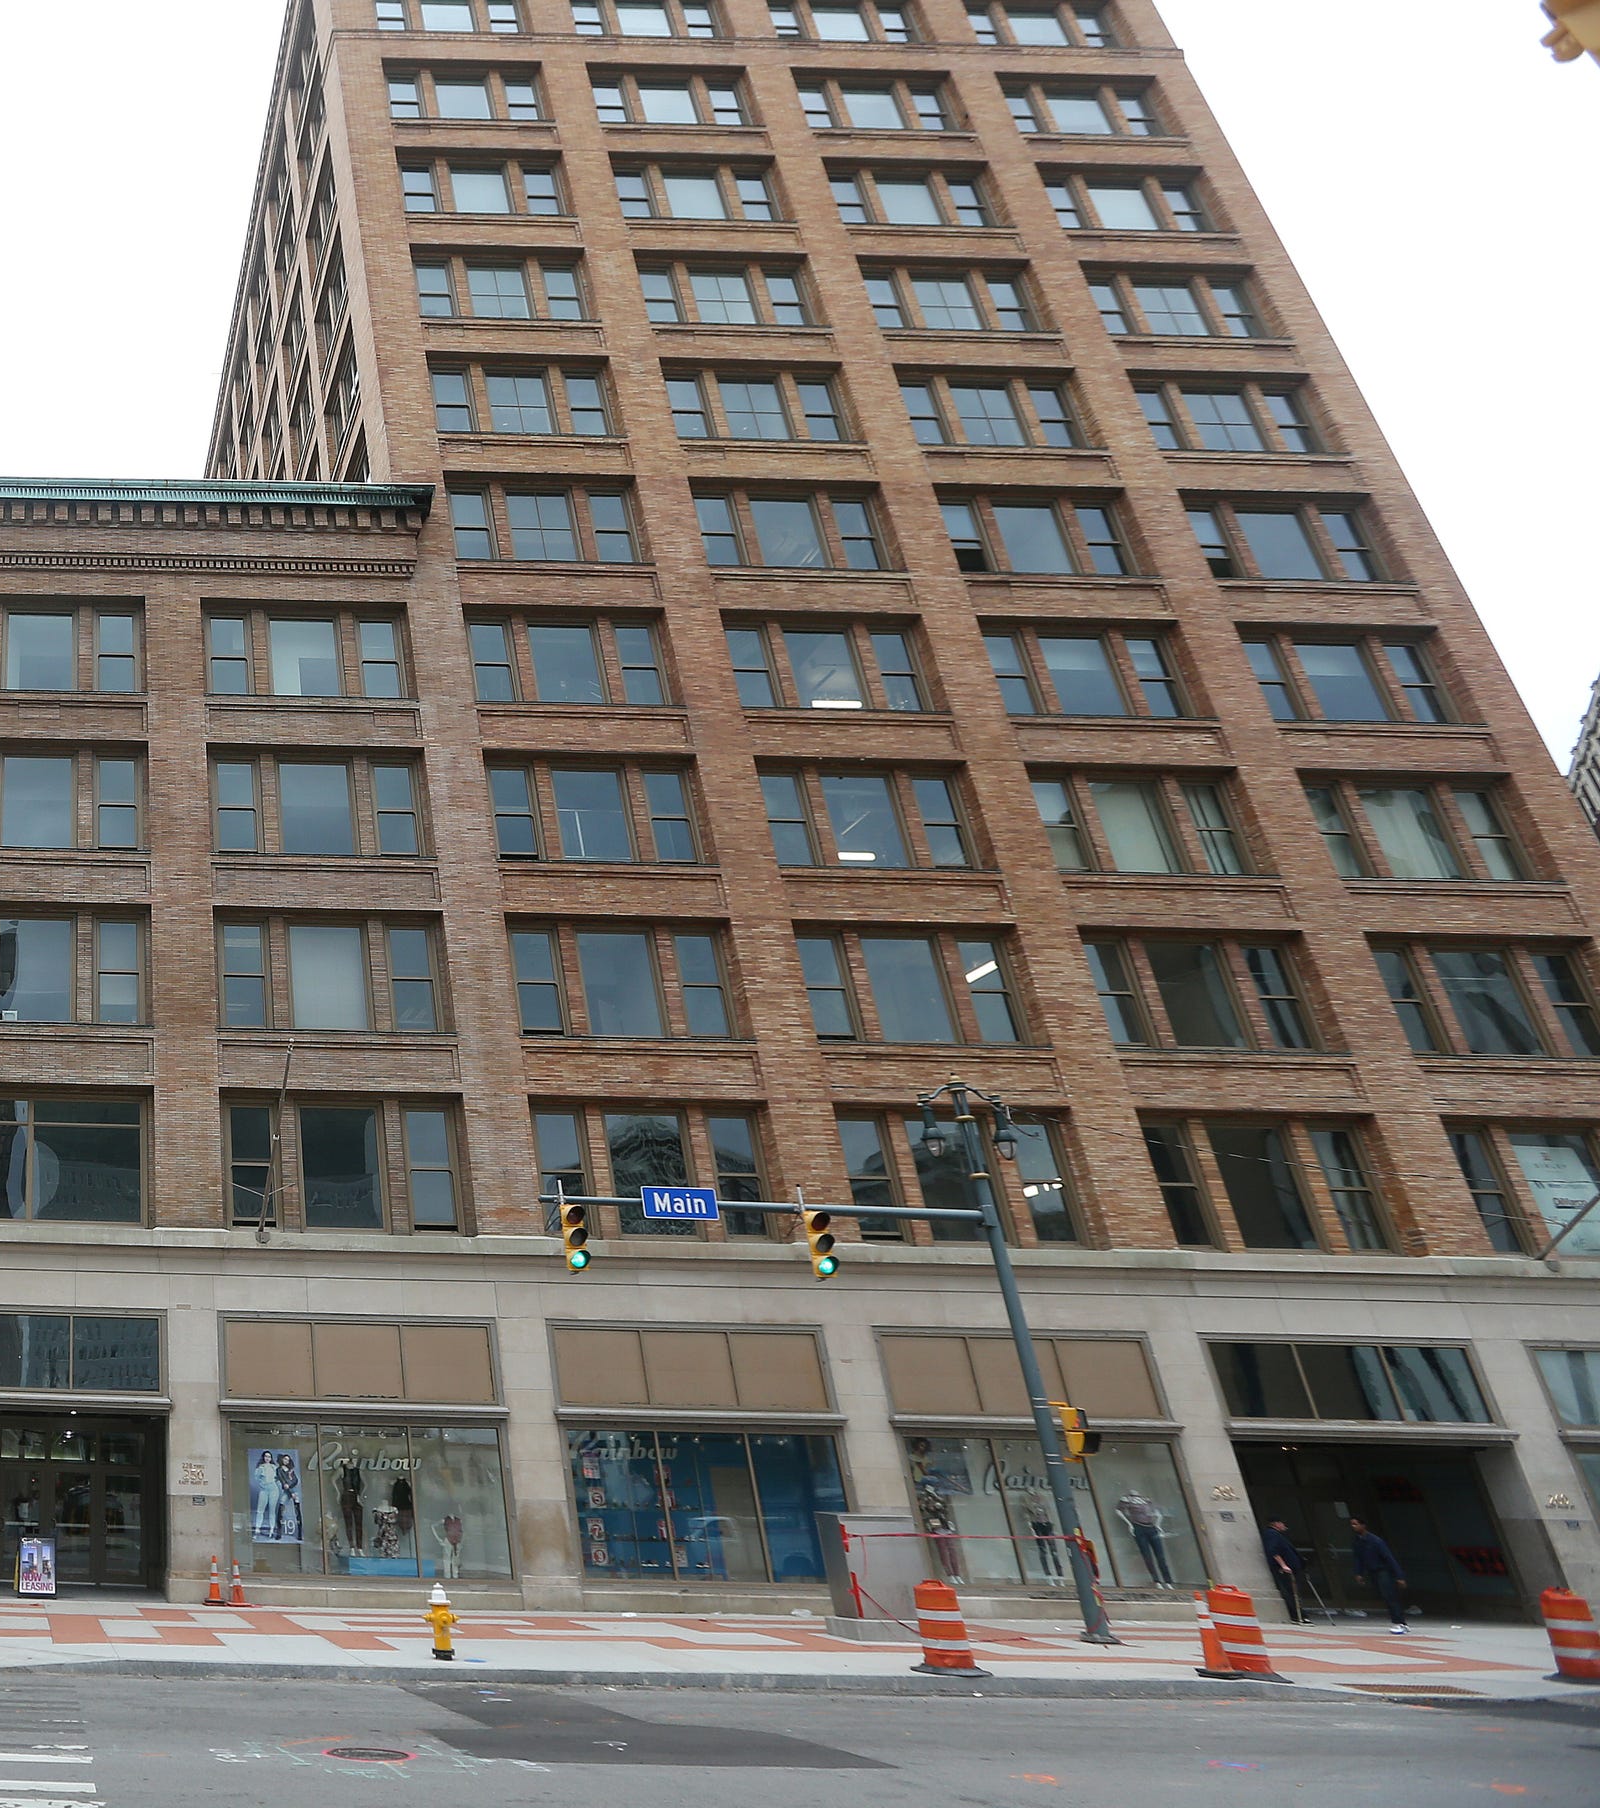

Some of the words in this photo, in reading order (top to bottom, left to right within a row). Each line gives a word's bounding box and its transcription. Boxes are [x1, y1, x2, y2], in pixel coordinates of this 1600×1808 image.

[653, 1192, 707, 1214] Main
[307, 1441, 422, 1471] Rainbow
[22, 1573, 42, 1582] NOW
[22, 1581, 54, 1591] LEASING
